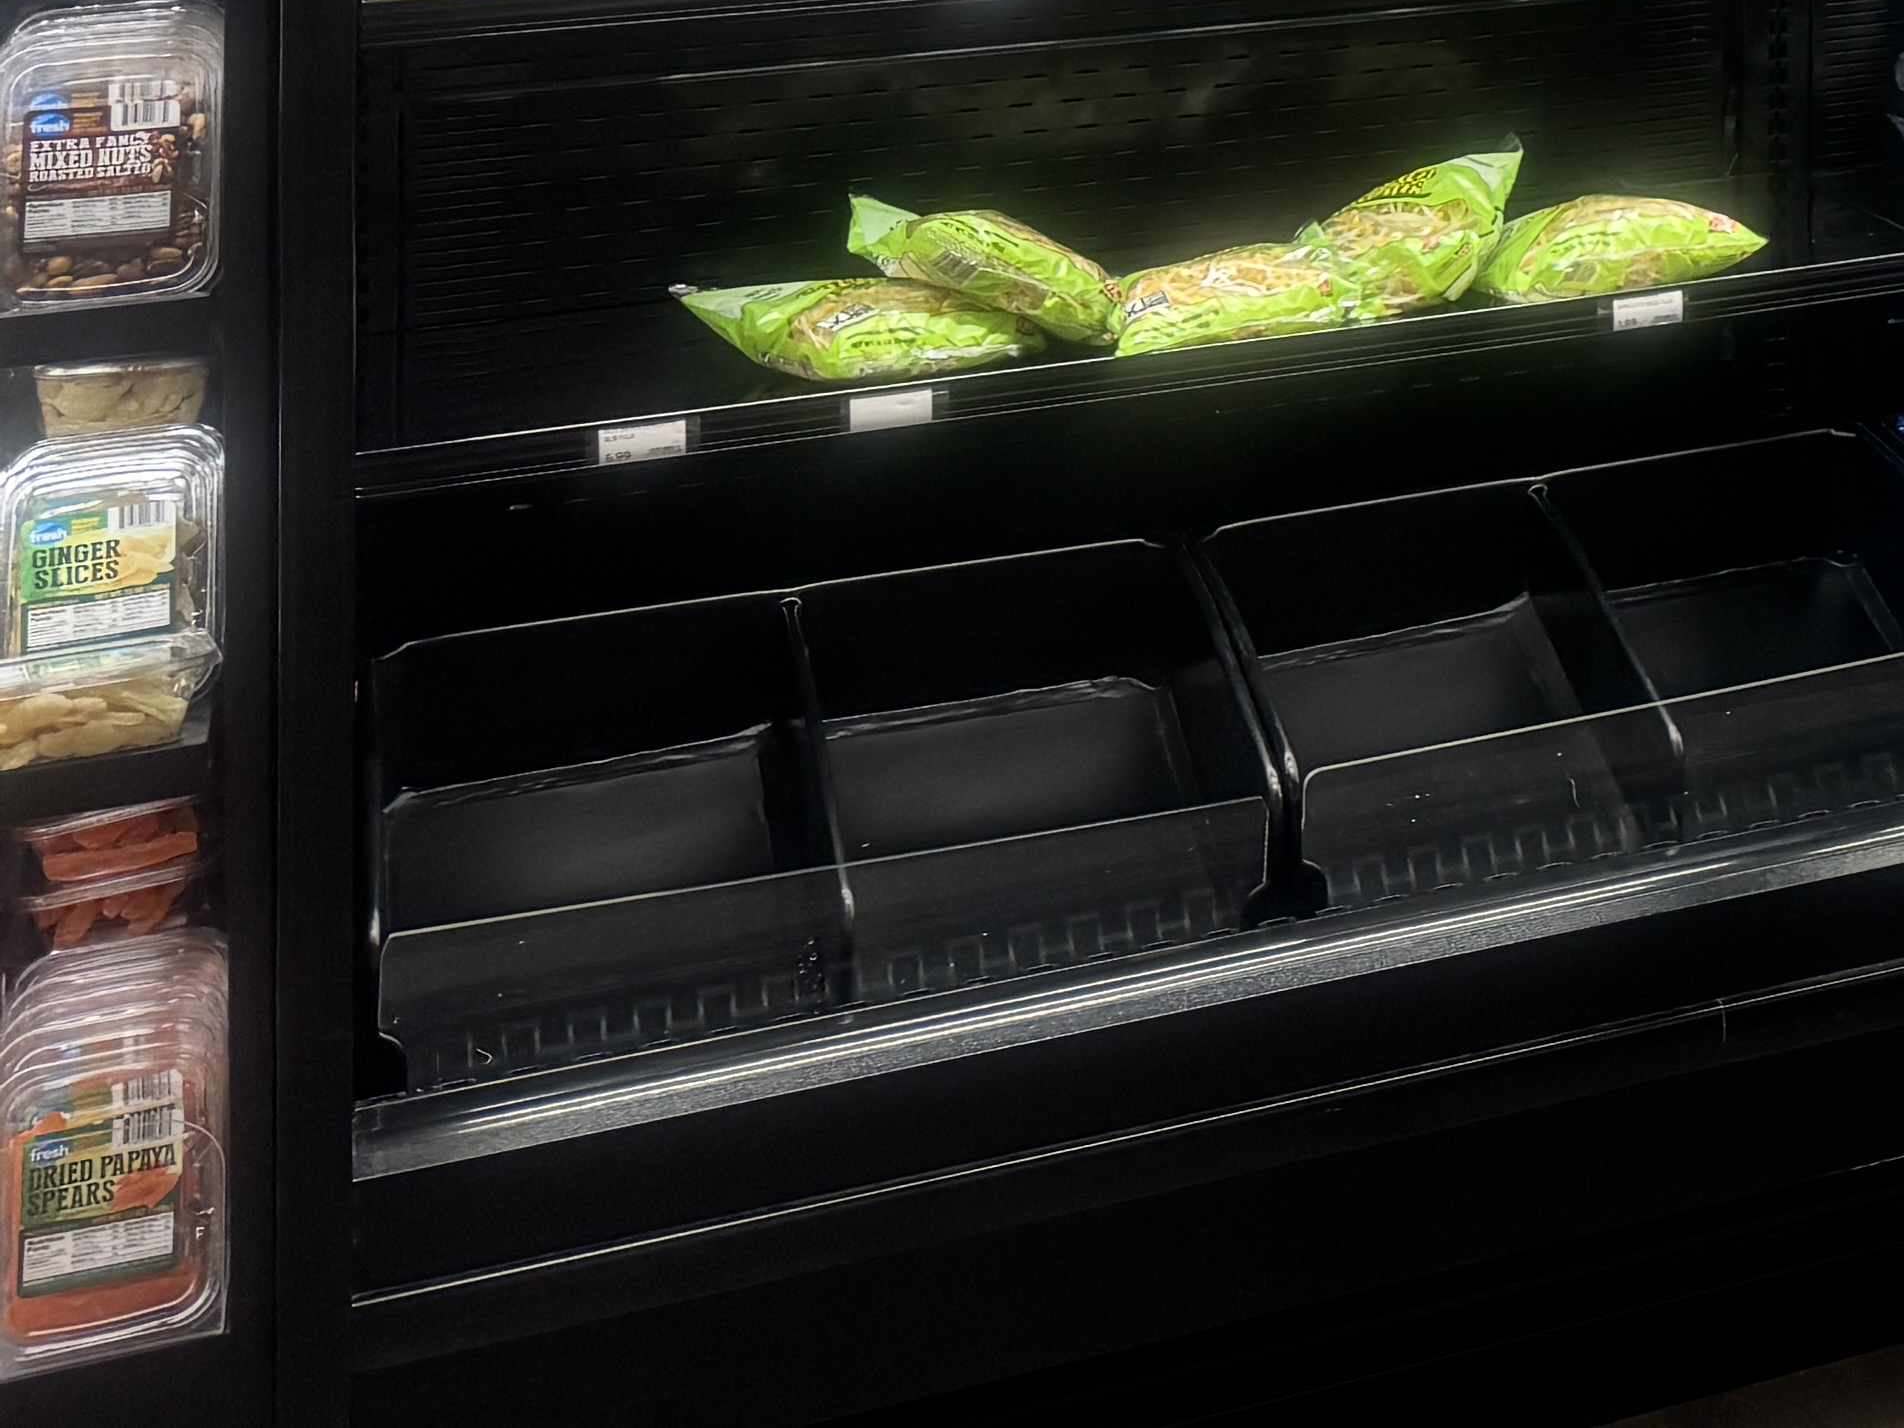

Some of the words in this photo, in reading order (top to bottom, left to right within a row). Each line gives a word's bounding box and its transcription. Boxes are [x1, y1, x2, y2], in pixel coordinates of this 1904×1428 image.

[30, 138, 90, 152] EXTRA
[96, 132, 152, 147] FANCY
[29, 150, 93, 170] MIXED
[97, 145, 152, 167] NUTS
[29, 168, 94, 182] ROASTED
[96, 162, 151, 178] SALTED
[32, 539, 122, 569] GINGER
[34, 560, 120, 590] SLICES
[28, 1159, 93, 1191] DRIED
[100, 1143, 177, 1179] PAPAYA
[30, 1145, 69, 1162] fresh
[26, 1180, 116, 1217] SPEARS
